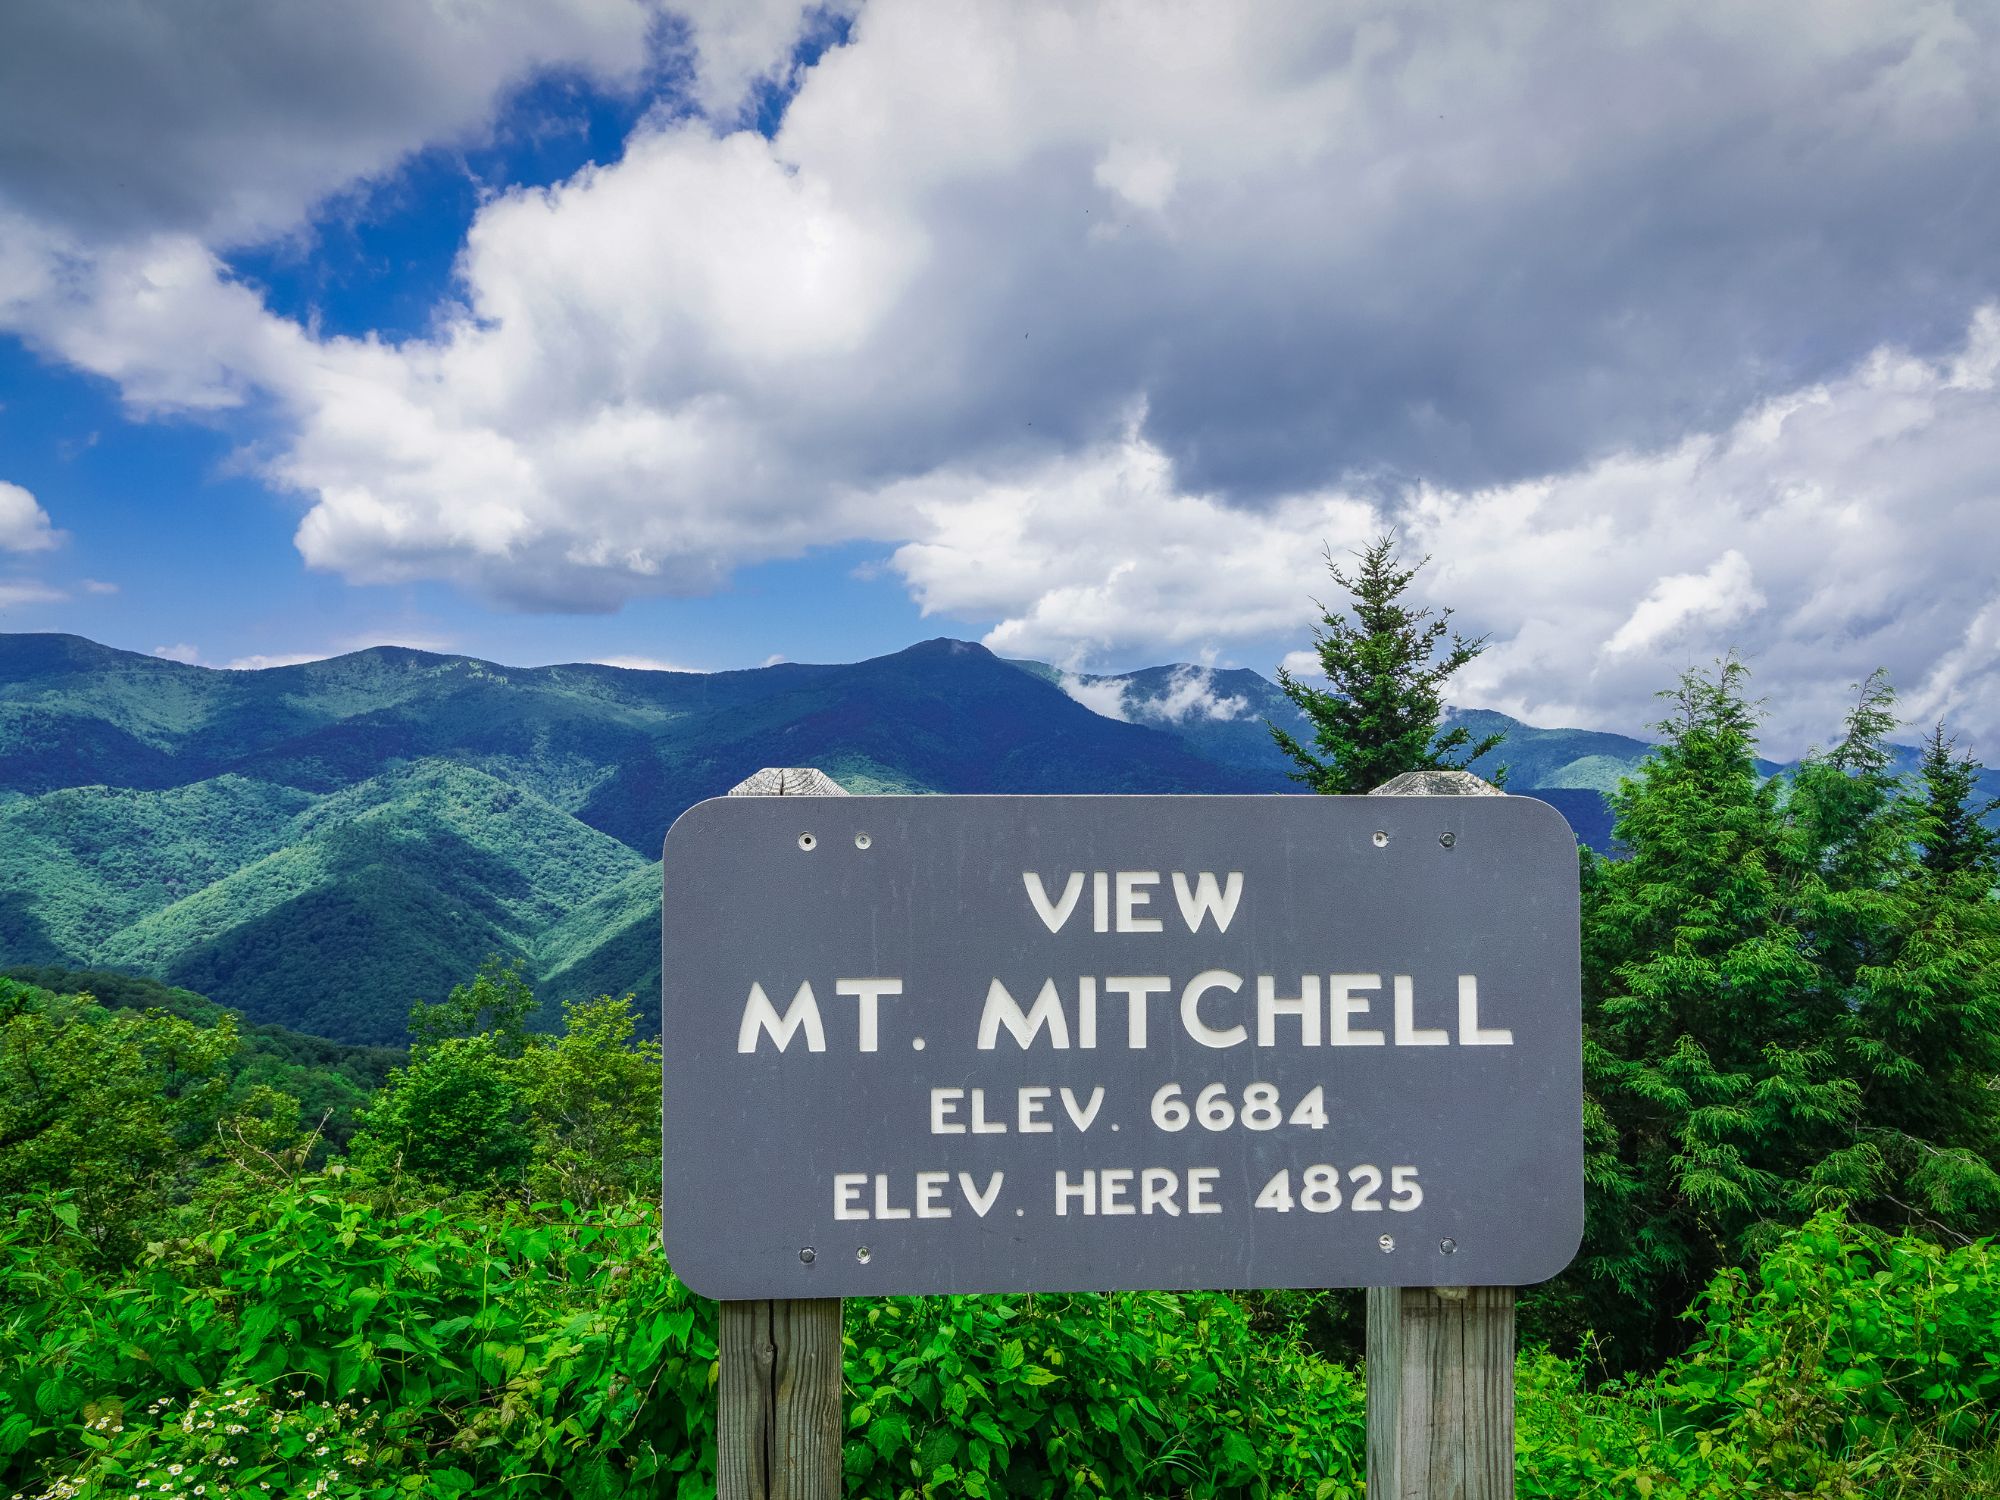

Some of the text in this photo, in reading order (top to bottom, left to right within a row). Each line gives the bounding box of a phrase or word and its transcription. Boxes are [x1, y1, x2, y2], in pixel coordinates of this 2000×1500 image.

[1022, 871, 1244, 934] VIEW
[737, 969, 1514, 1054] MT. MITCHELL
[930, 1082, 1330, 1134] ELEV. 6684
[833, 1164, 1424, 1221] ELEV. HERE 4825
